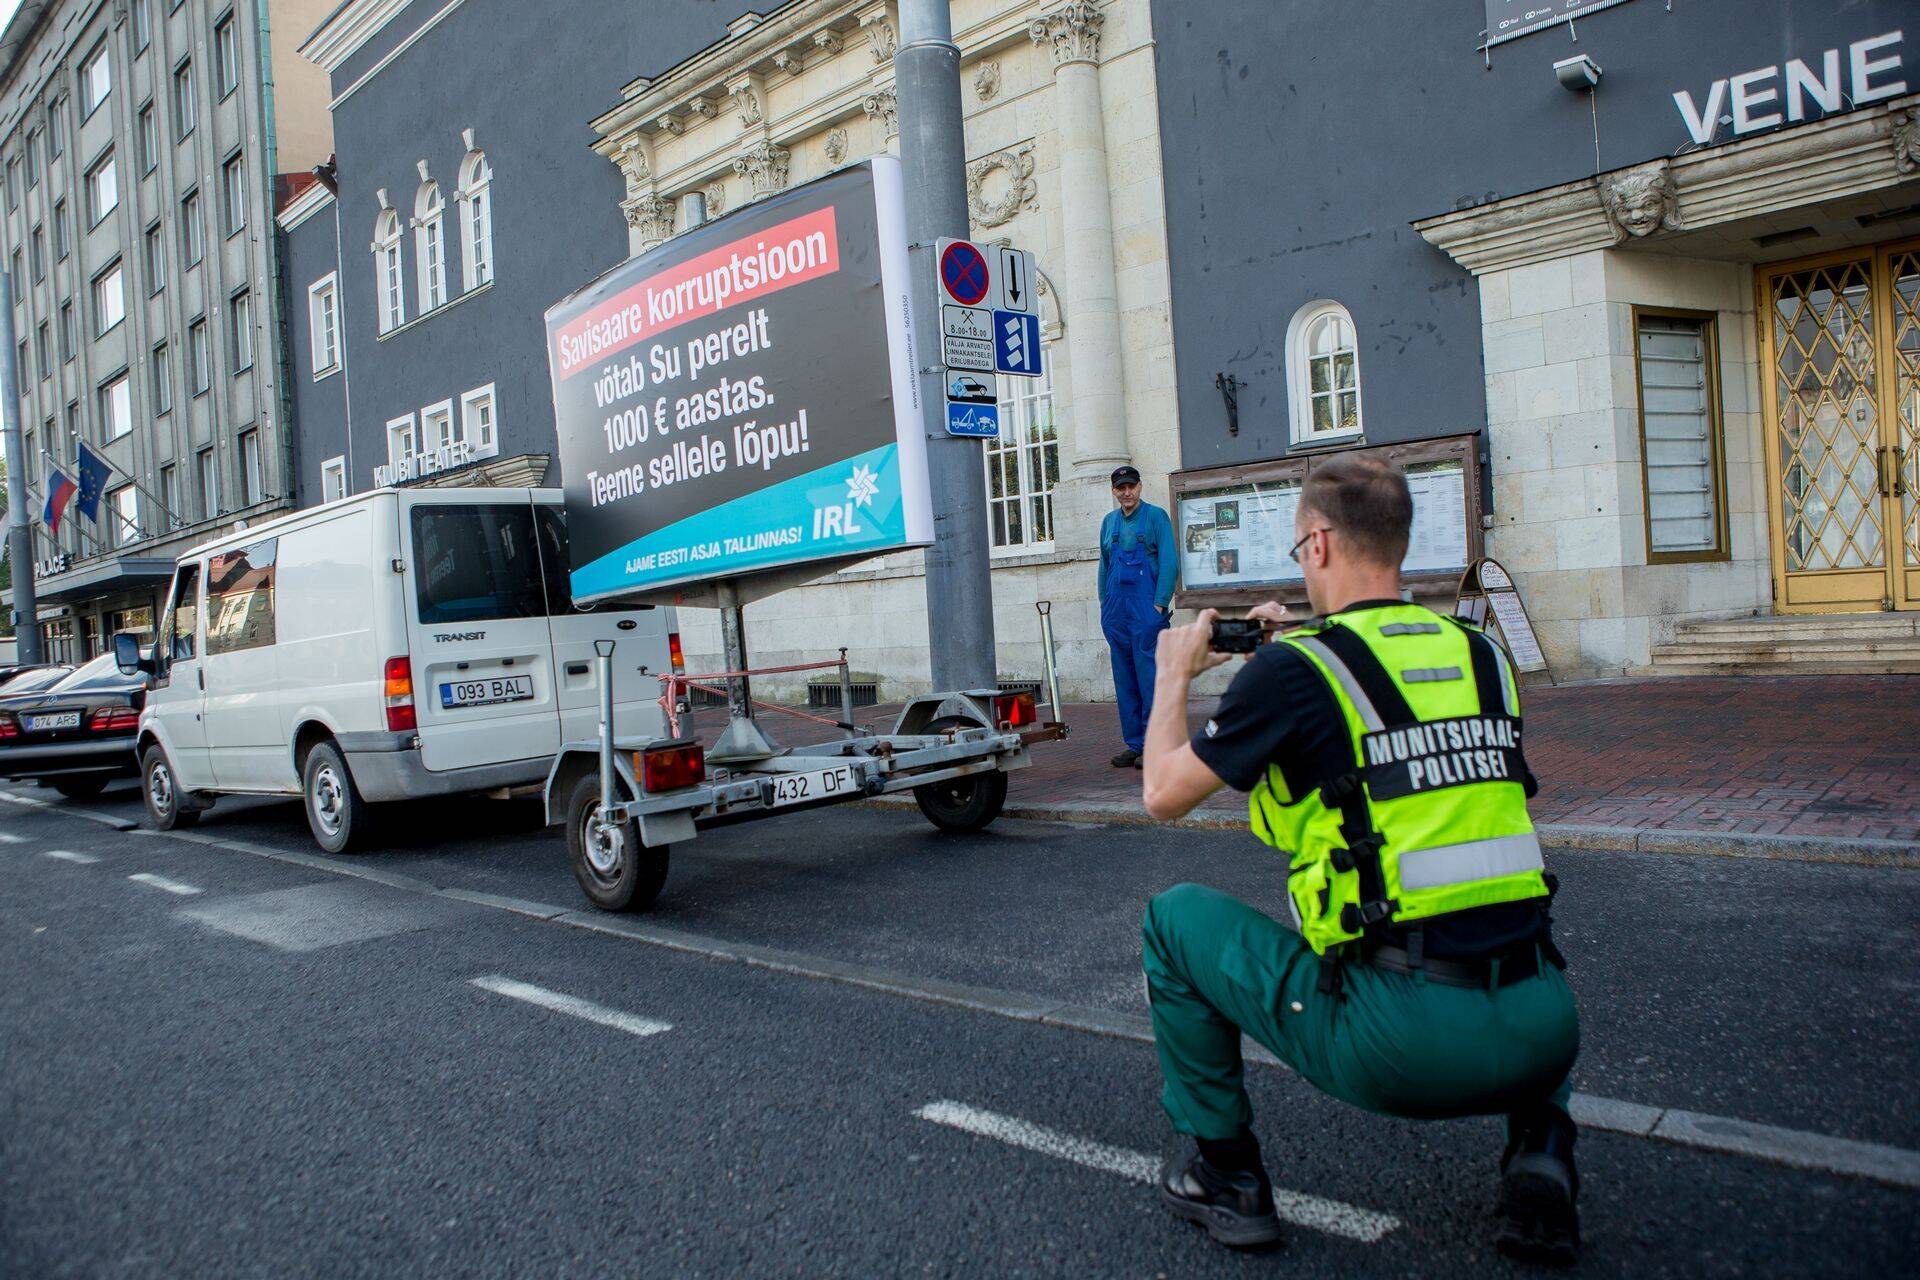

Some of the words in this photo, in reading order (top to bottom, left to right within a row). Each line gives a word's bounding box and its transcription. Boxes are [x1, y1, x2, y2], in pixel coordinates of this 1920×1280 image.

[1672, 30, 1907, 144] VENE
[560, 303, 642, 370] Savisaare
[647, 231, 828, 325] korruptsioon
[902, 295, 911, 329] 56250350
[594, 355, 645, 408] võtab
[650, 344, 681, 385] Su
[688, 308, 772, 381] perelt
[950, 357, 989, 367] ERILUBADEGA
[967, 342, 991, 350] ARVATUD
[604, 404, 649, 454] 1000
[654, 396, 669, 436] €
[675, 375, 774, 431] aastas.
[417, 442, 471, 476] TEATER
[587, 464, 644, 507] Teeme
[649, 435, 726, 489] sellele
[733, 409, 810, 471] lõpu!
[812, 502, 861, 540] IRL
[34, 553, 65, 580] PALACE
[625, 554, 656, 574] AJAME
[658, 547, 688, 567] EESTI
[690, 541, 721, 561] ASJA
[723, 526, 802, 554] TALLINNAS!
[433, 631, 486, 642] TRANSIT
[457, 684, 485, 700] 093
[492, 679, 525, 697] BAL
[35, 717, 51, 728] 074
[57, 714, 77, 726] ARS
[1366, 718, 1521, 766] MUNITSIPAAL-
[1407, 750, 1509, 790] POLITSEI
[778, 777, 809, 801] 432
